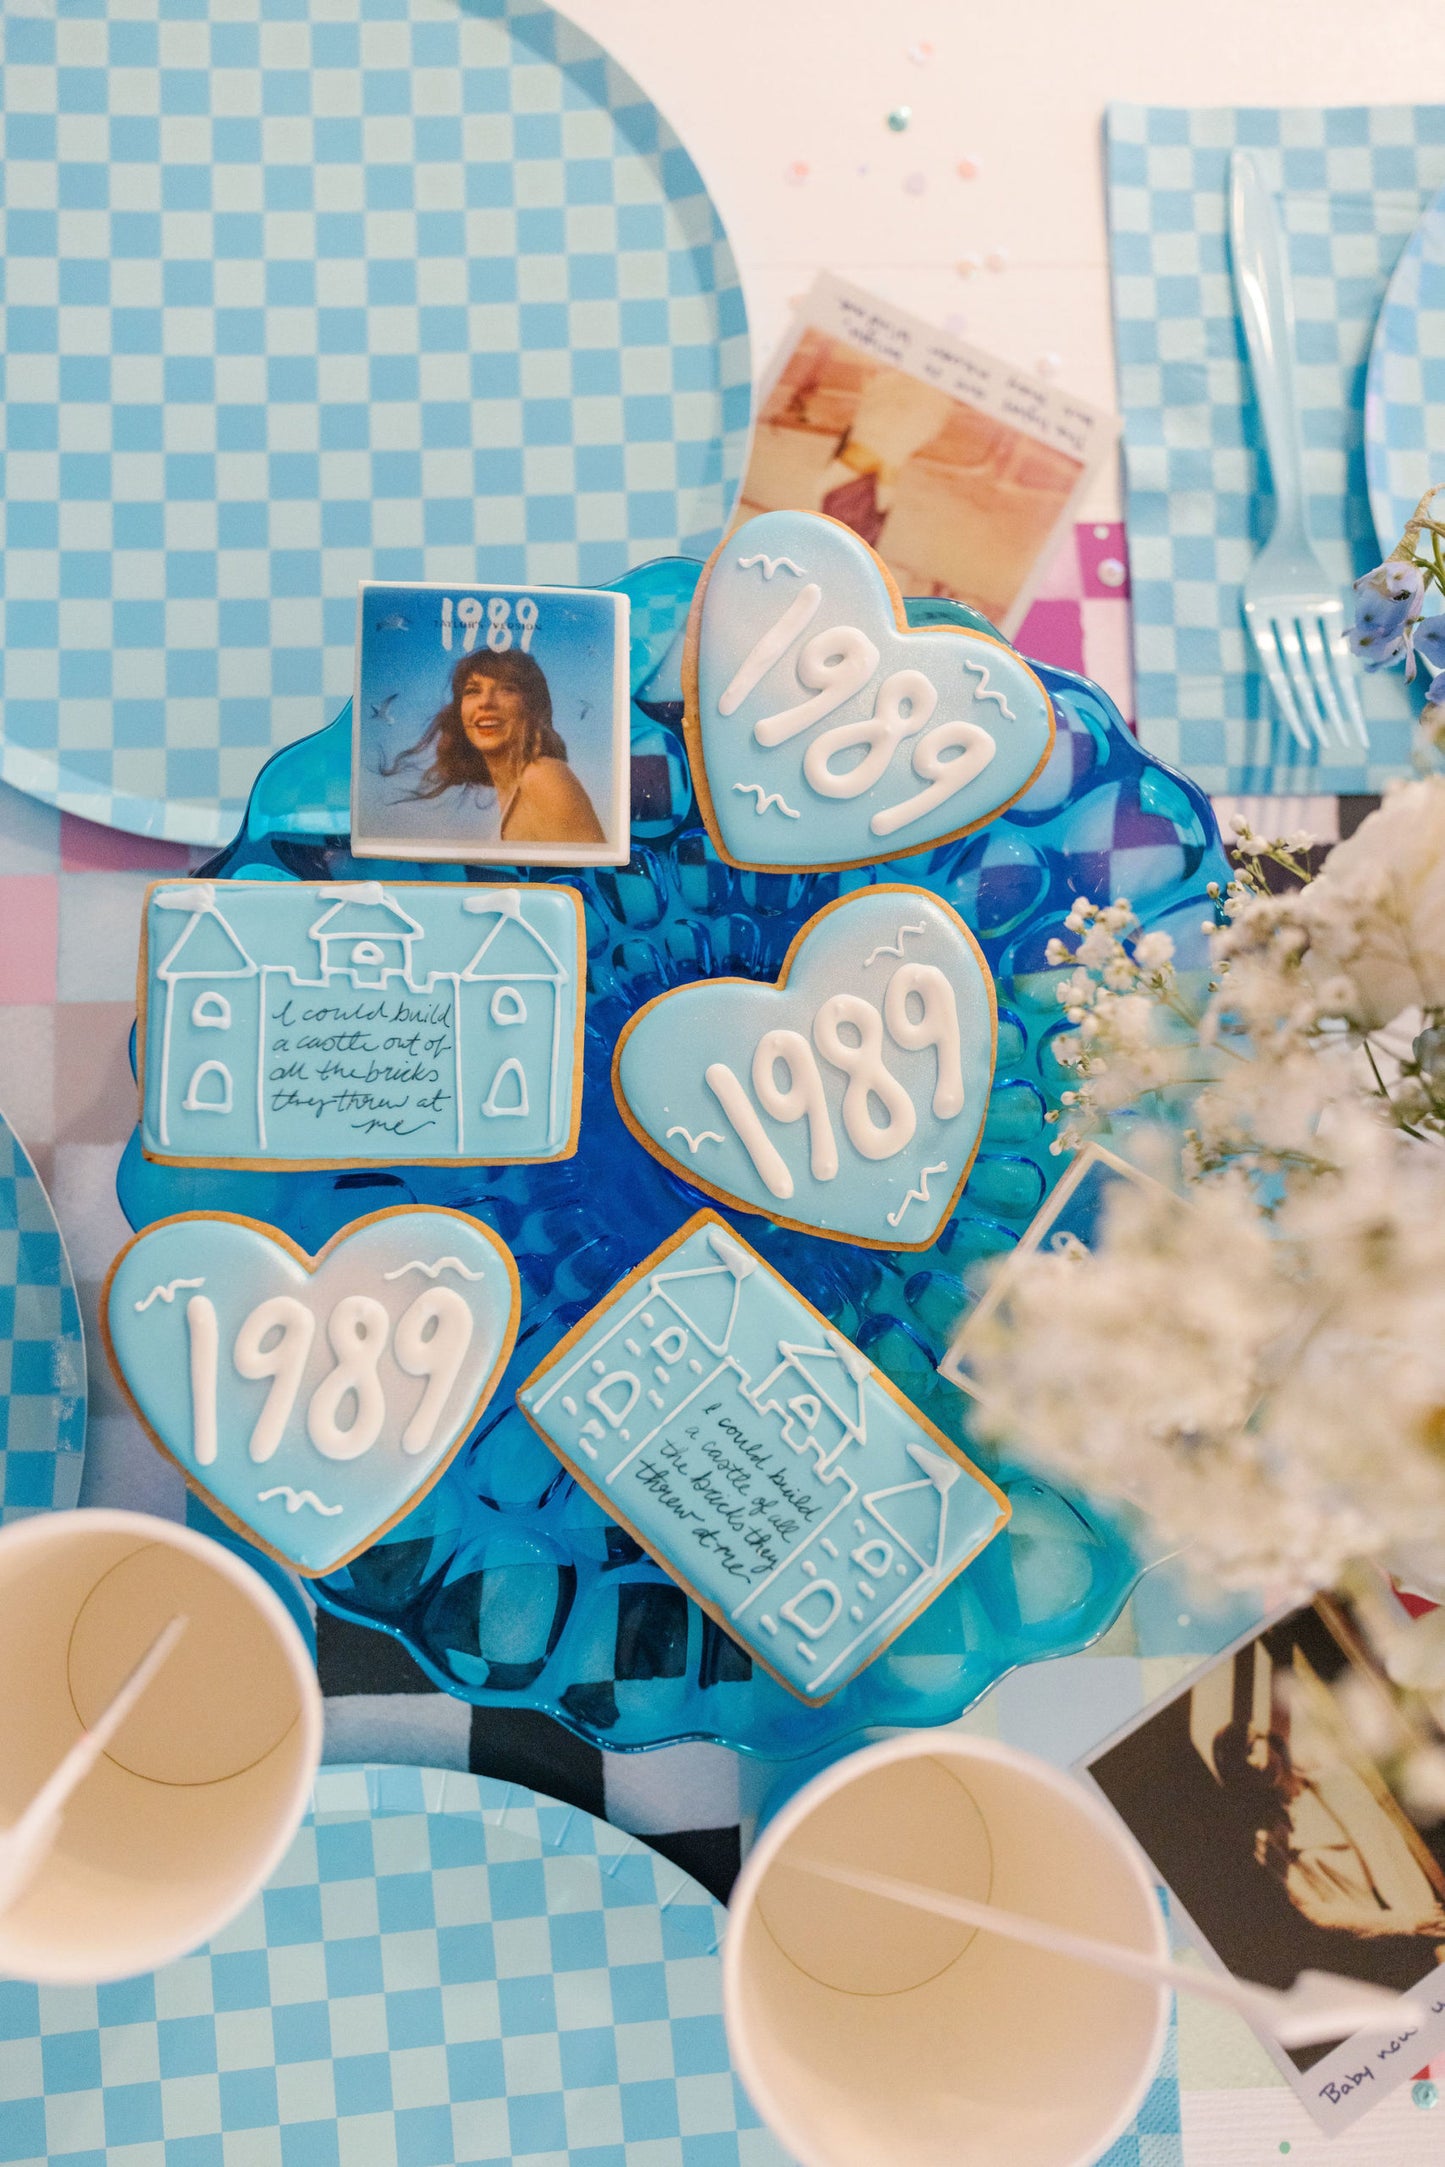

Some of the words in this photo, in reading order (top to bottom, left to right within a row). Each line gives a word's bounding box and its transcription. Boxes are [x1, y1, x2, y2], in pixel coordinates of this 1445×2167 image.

[442, 597, 539, 653] 1989
[719, 584, 996, 836] 1989
[272, 1038, 289, 1051] a
[296, 1031, 379, 1051] castle
[383, 1032, 420, 1056] out
[424, 1034, 451, 1059] of
[302, 1001, 388, 1021] could
[389, 1001, 451, 1027] build
[269, 1061, 308, 1081] all
[316, 1060, 365, 1081] the
[365, 1060, 439, 1082] bricks
[272, 1088, 335, 1118] they
[333, 1088, 409, 1112] threw
[417, 1089, 451, 1112] at
[705, 963, 964, 1199] 1989
[351, 1119, 436, 1136] me
[187, 1287, 473, 1465] 1989
[660, 1439, 688, 1475] the
[691, 1472, 745, 1532] bricks
[744, 1527, 778, 1573] they
[685, 1427, 699, 1440] a
[701, 1441, 751, 1496] castle
[749, 1498, 779, 1515] of
[768, 1515, 800, 1543] all
[718, 1418, 773, 1470] could
[768, 1468, 822, 1522] build
[635, 1460, 705, 1522] threw
[692, 1528, 721, 1547] at
[714, 1544, 751, 1584] me
[1319, 2066, 1375, 2104] Baby
